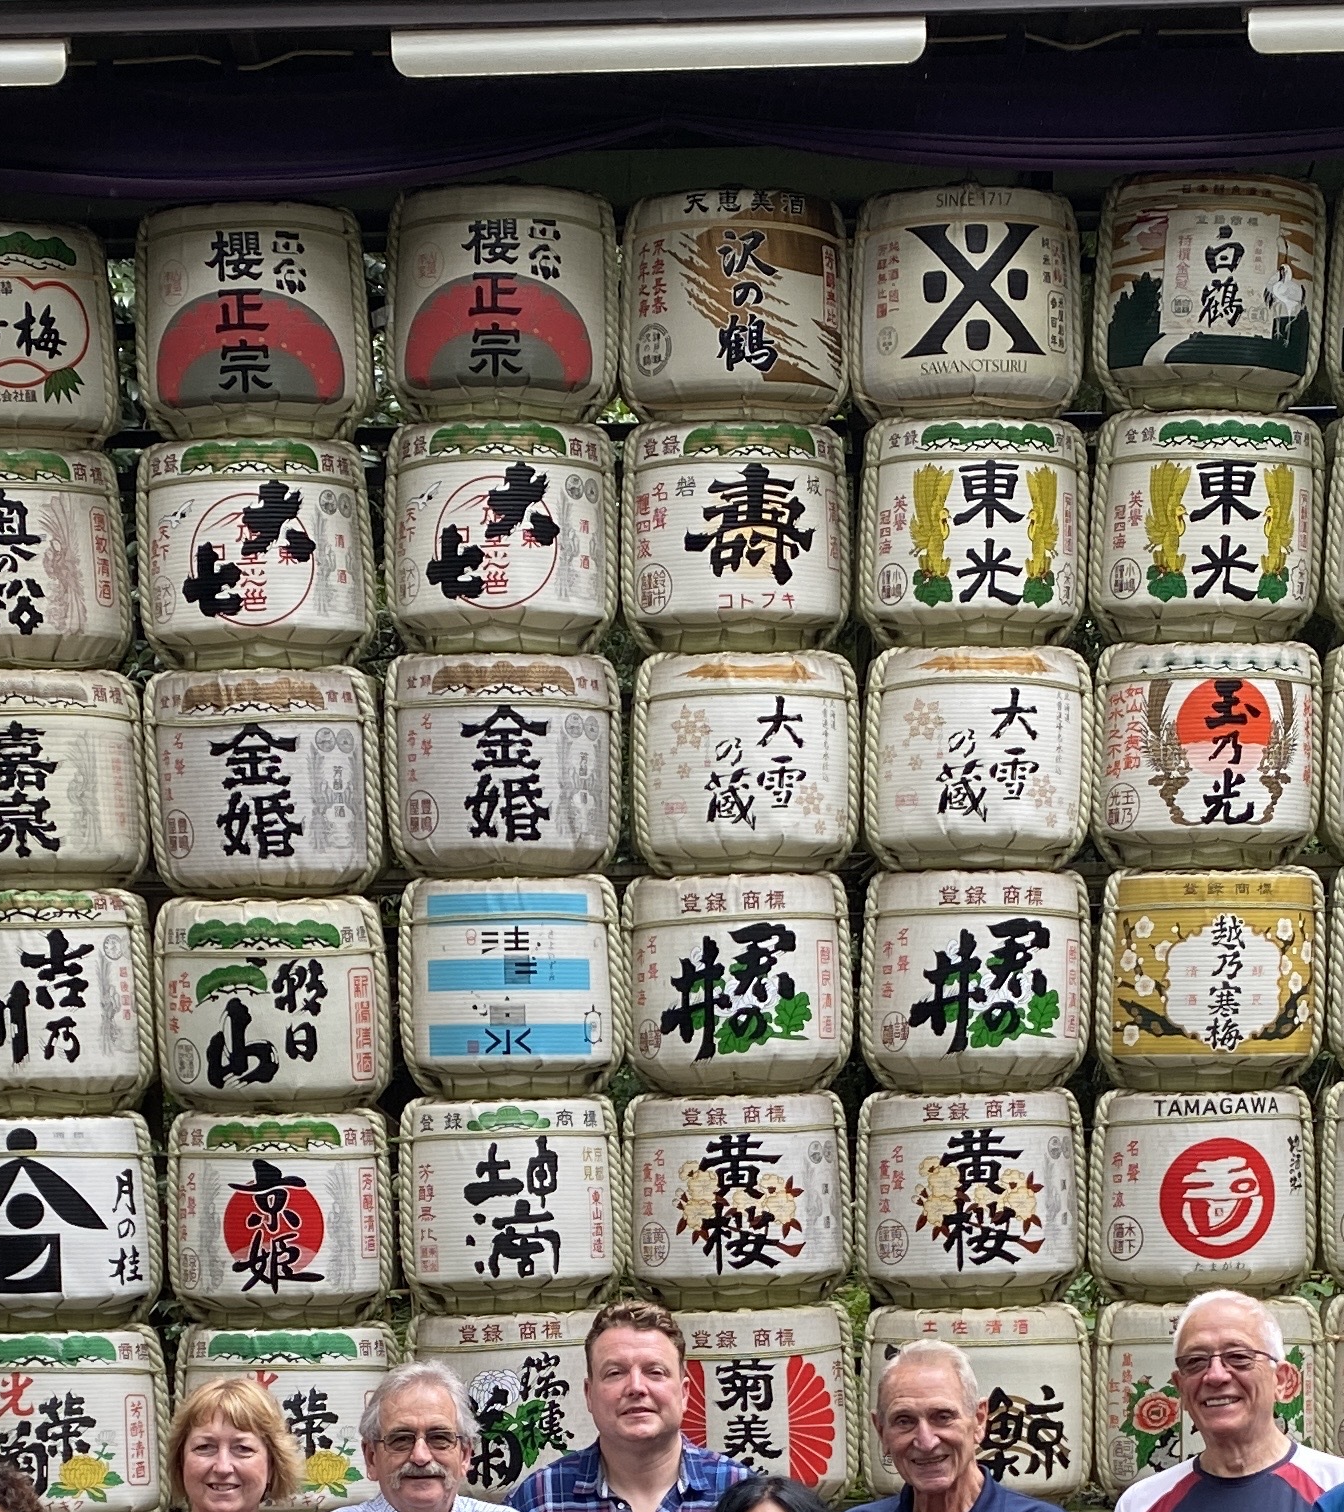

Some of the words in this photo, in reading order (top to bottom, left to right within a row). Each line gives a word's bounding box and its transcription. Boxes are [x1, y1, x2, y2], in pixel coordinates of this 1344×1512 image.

[683, 192, 806, 214] 天恵美酒
[936, 193, 975, 207] SINCE
[981, 192, 1012, 206] 1717
[205, 230, 272, 394] 櫻正宗
[461, 219, 522, 378] 櫻正宗
[716, 229, 779, 374] 沢の鶴
[1199, 226, 1244, 328] 白鶴
[921, 359, 1027, 376] SAWANOTSURU
[183, 480, 316, 617] 大七
[426, 461, 560, 600] 大七
[953, 460, 1025, 605] 東光
[1189, 459, 1262, 602] 東光
[718, 592, 795, 610] コトブキ
[207, 723, 305, 859] 金婚
[459, 705, 550, 842] 金婚
[757, 696, 806, 809] 大雪
[989, 688, 1039, 801] 大雪
[1202, 678, 1261, 825] 玉乃光
[682, 893, 727, 913] 登録
[743, 891, 785, 910] 商標
[661, 922, 797, 1062] 君の井
[910, 918, 1050, 1062] 君の井
[1205, 915, 1243, 1051] 越乃寒梅
[682, 1108, 727, 1126] 登録
[743, 1105, 786, 1124] 商標
[1154, 1096, 1279, 1118] TAMAGAWA
[108, 1169, 143, 1286] 月の桂
[228, 1159, 325, 1294] 京姫
[700, 1132, 784, 1275] 黄桜
[941, 1129, 1024, 1272] 黄桜
[1194, 1261, 1246, 1272] たまがわ
[460, 1325, 503, 1344] 登録
[519, 1321, 563, 1341] 商標
[922, 1320, 967, 1334] 土佐
[987, 1318, 1029, 1336] 清酒
[129, 1401, 145, 1479] 芳醇清酒
